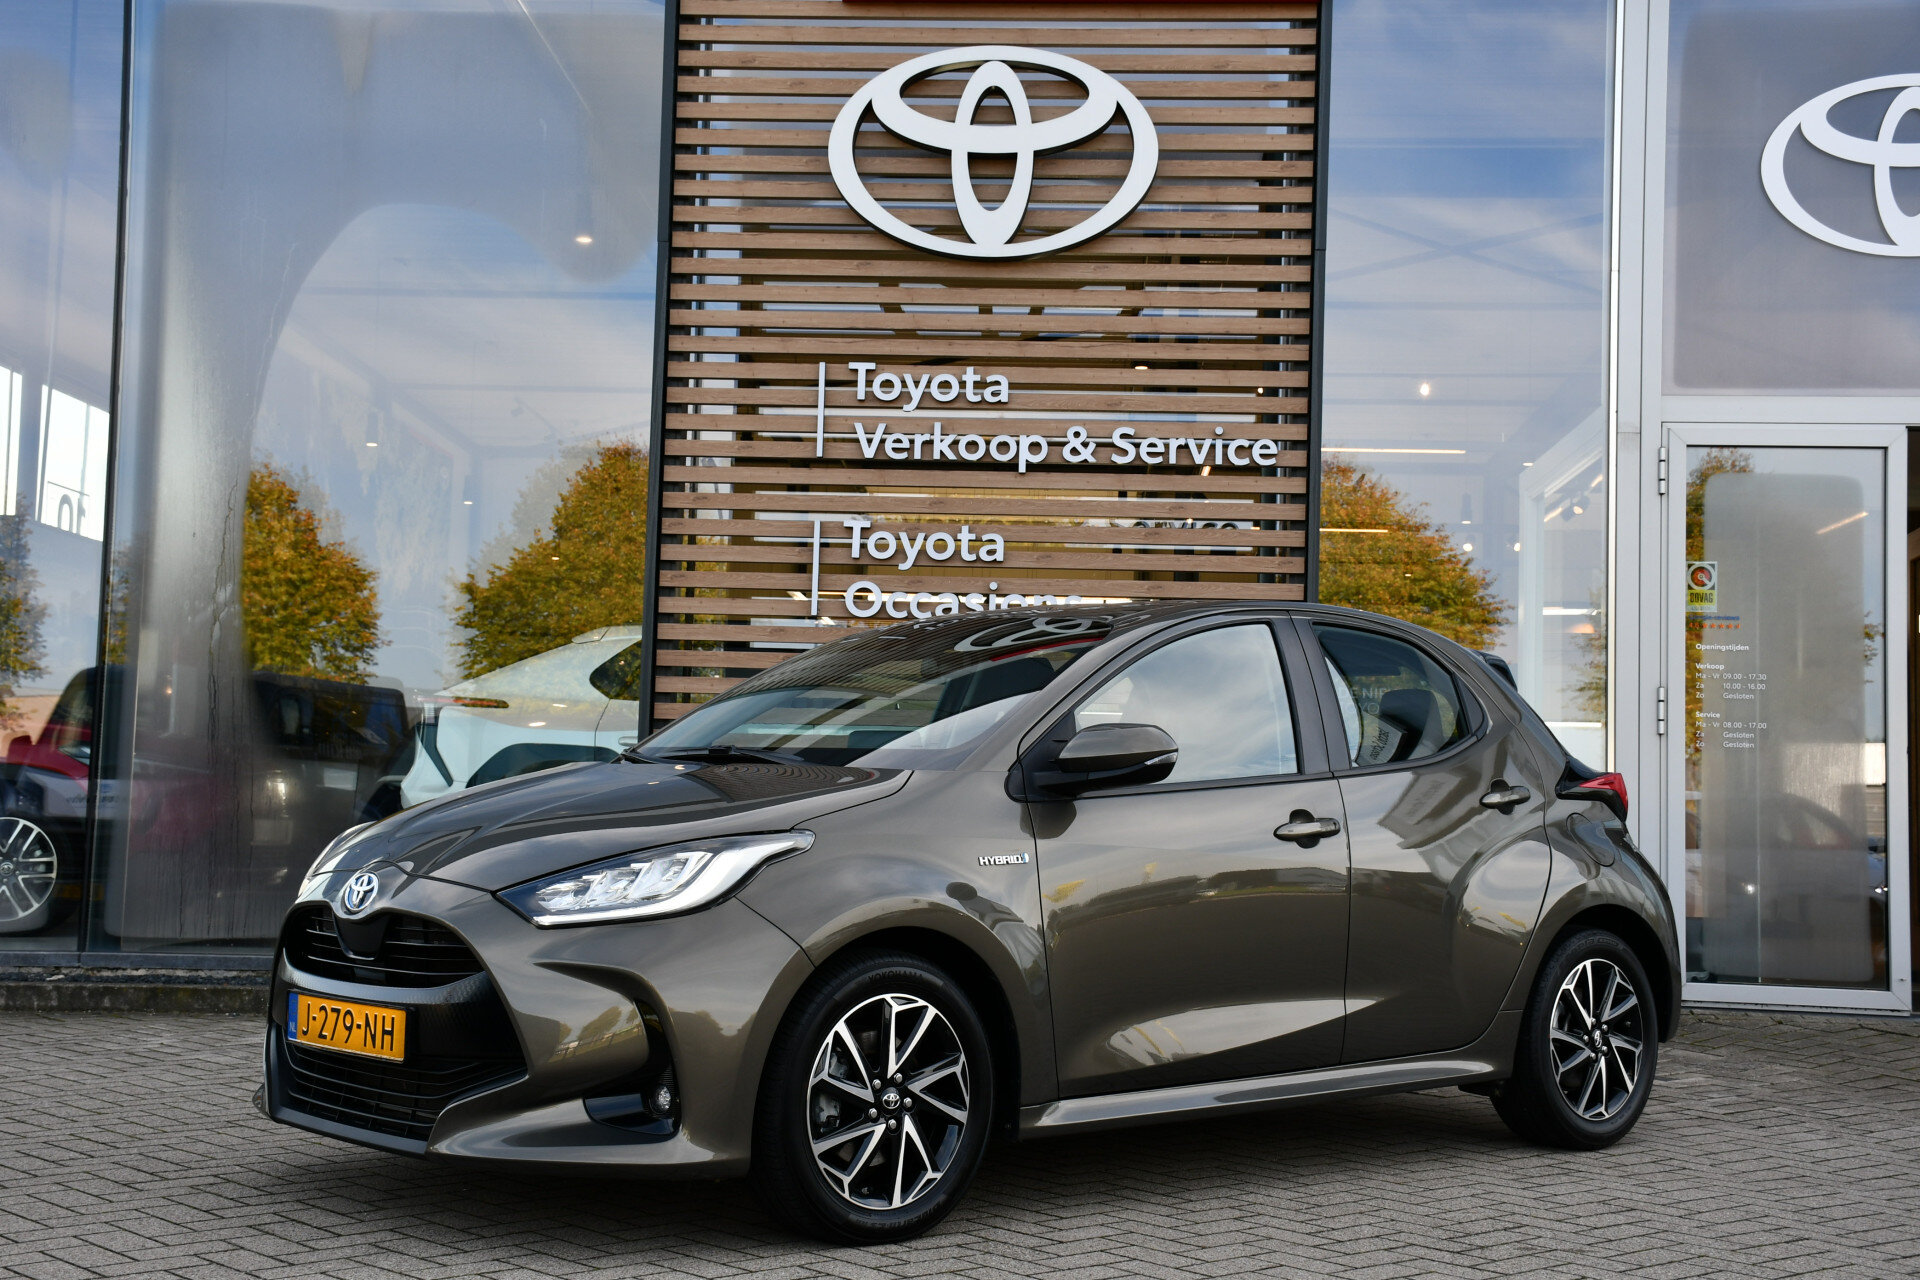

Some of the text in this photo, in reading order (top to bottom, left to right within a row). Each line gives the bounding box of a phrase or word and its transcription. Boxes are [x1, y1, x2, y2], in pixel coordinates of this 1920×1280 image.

[848, 361, 1010, 412] Toyota
[854, 422, 1278, 474] Verkoop & Service
[843, 520, 1005, 571] Toyota
[1695, 643, 1750, 652] Openingstijden
[1695, 663, 1725, 671] Verkoop
[1722, 692, 1754, 700] Gesloten
[1695, 711, 1721, 719] Service
[1722, 731, 1755, 739] Gesloten
[979, 855, 1023, 866] HYBRID
[302, 1001, 395, 1051] J-279-NH
